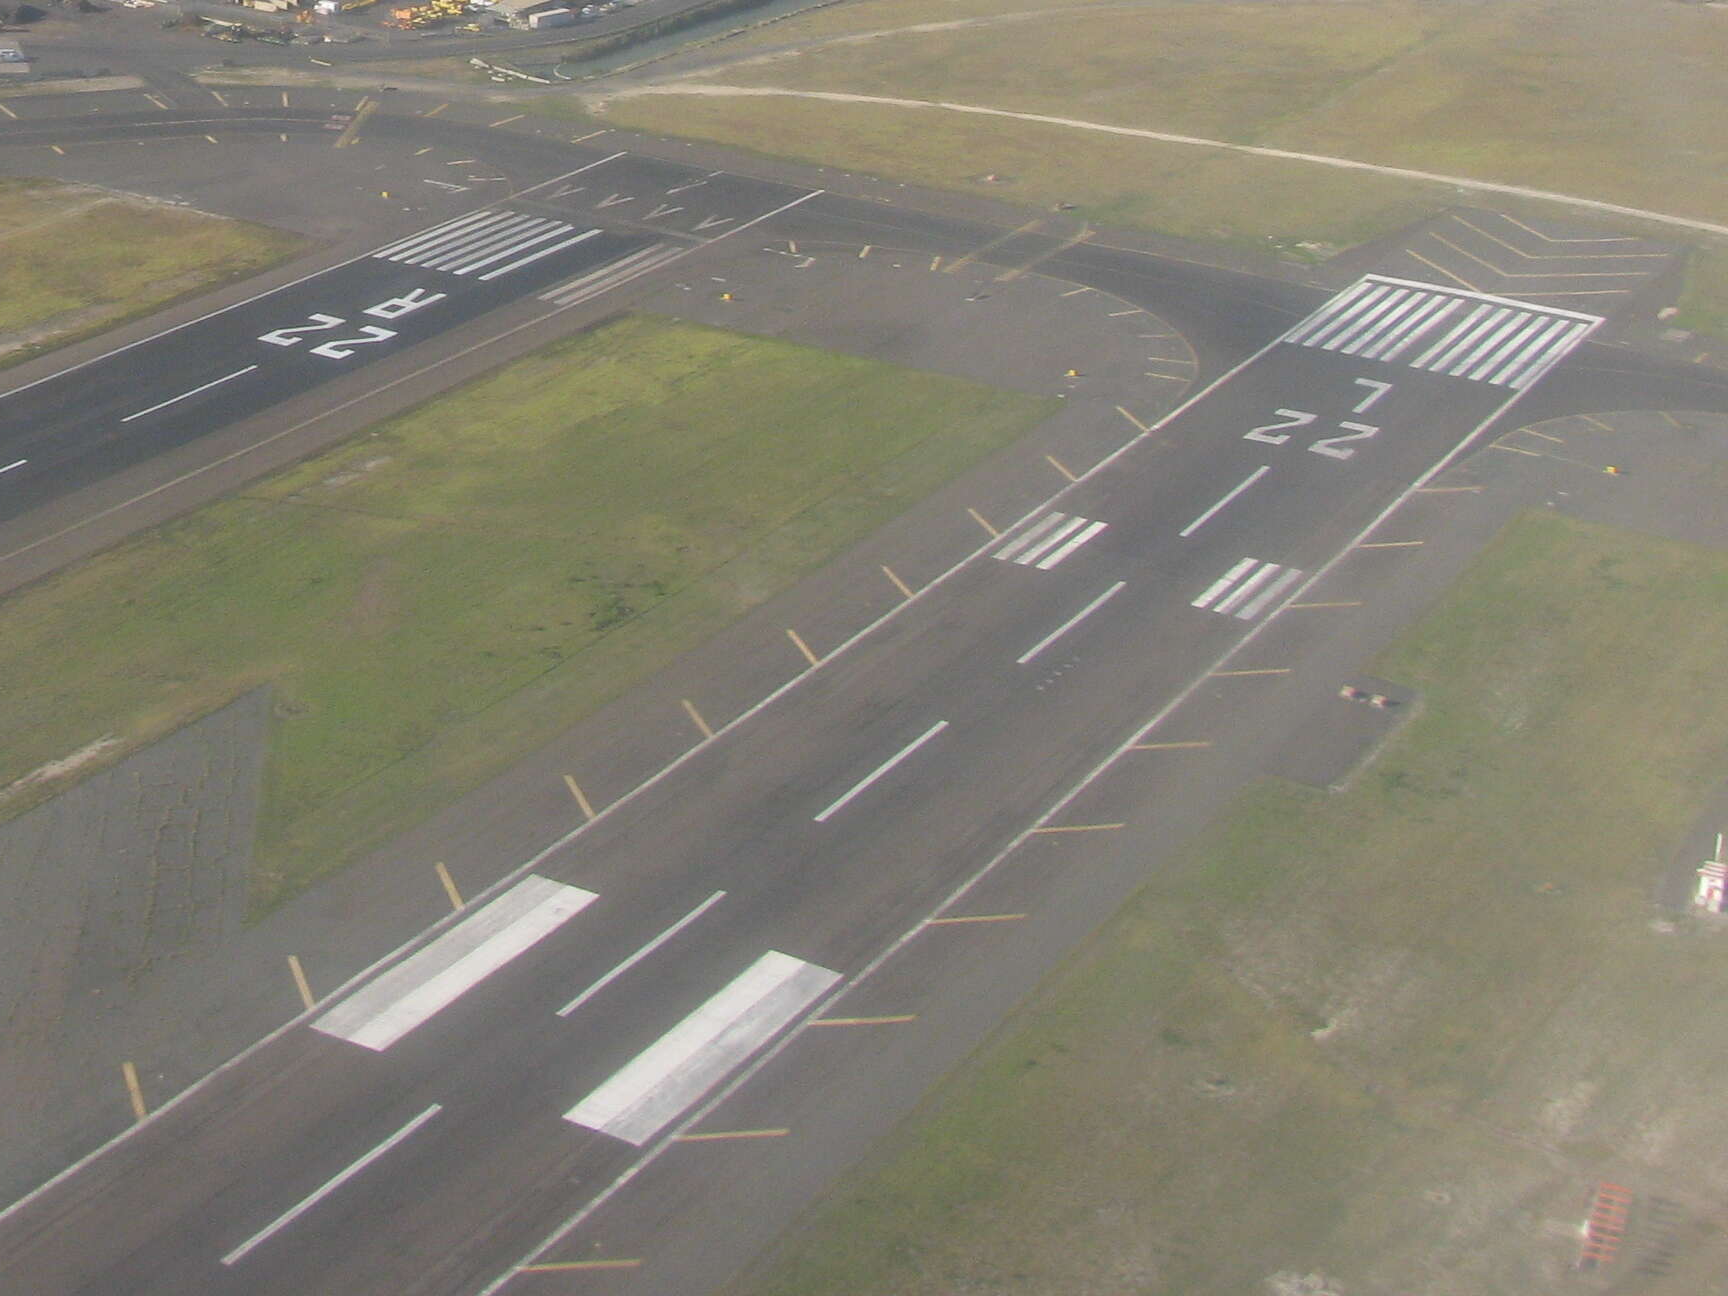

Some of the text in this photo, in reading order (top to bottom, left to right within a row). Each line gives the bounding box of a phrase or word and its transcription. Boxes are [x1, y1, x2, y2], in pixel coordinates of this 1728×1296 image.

[362, 287, 447, 319] R
[257, 313, 398, 360] 22
[1242, 408, 1380, 460] 22
